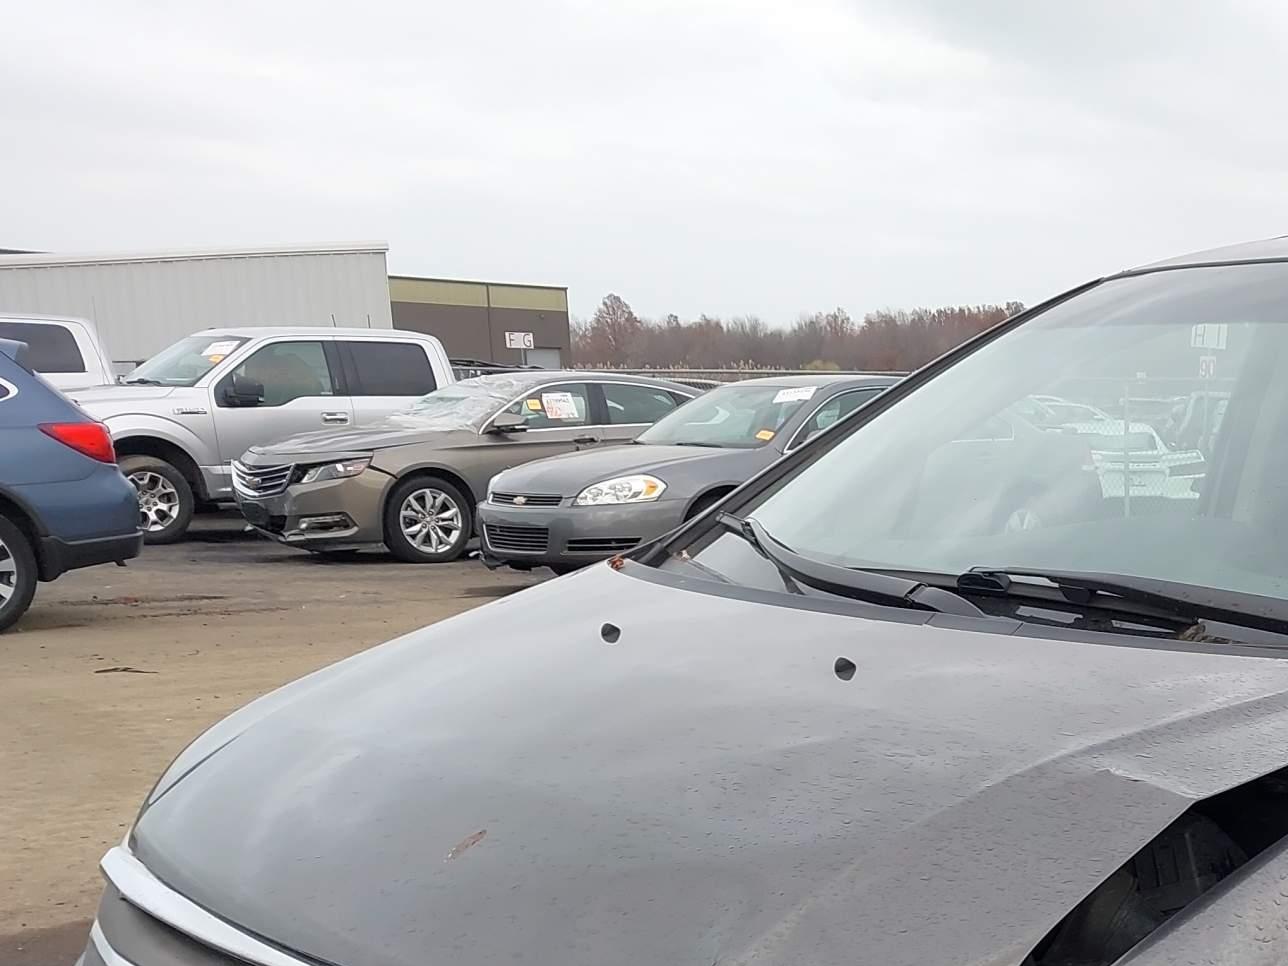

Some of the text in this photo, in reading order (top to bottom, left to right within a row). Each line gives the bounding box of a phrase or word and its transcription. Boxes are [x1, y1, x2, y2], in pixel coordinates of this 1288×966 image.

[509, 333, 532, 348] F G
[1201, 359, 1216, 377] 90
